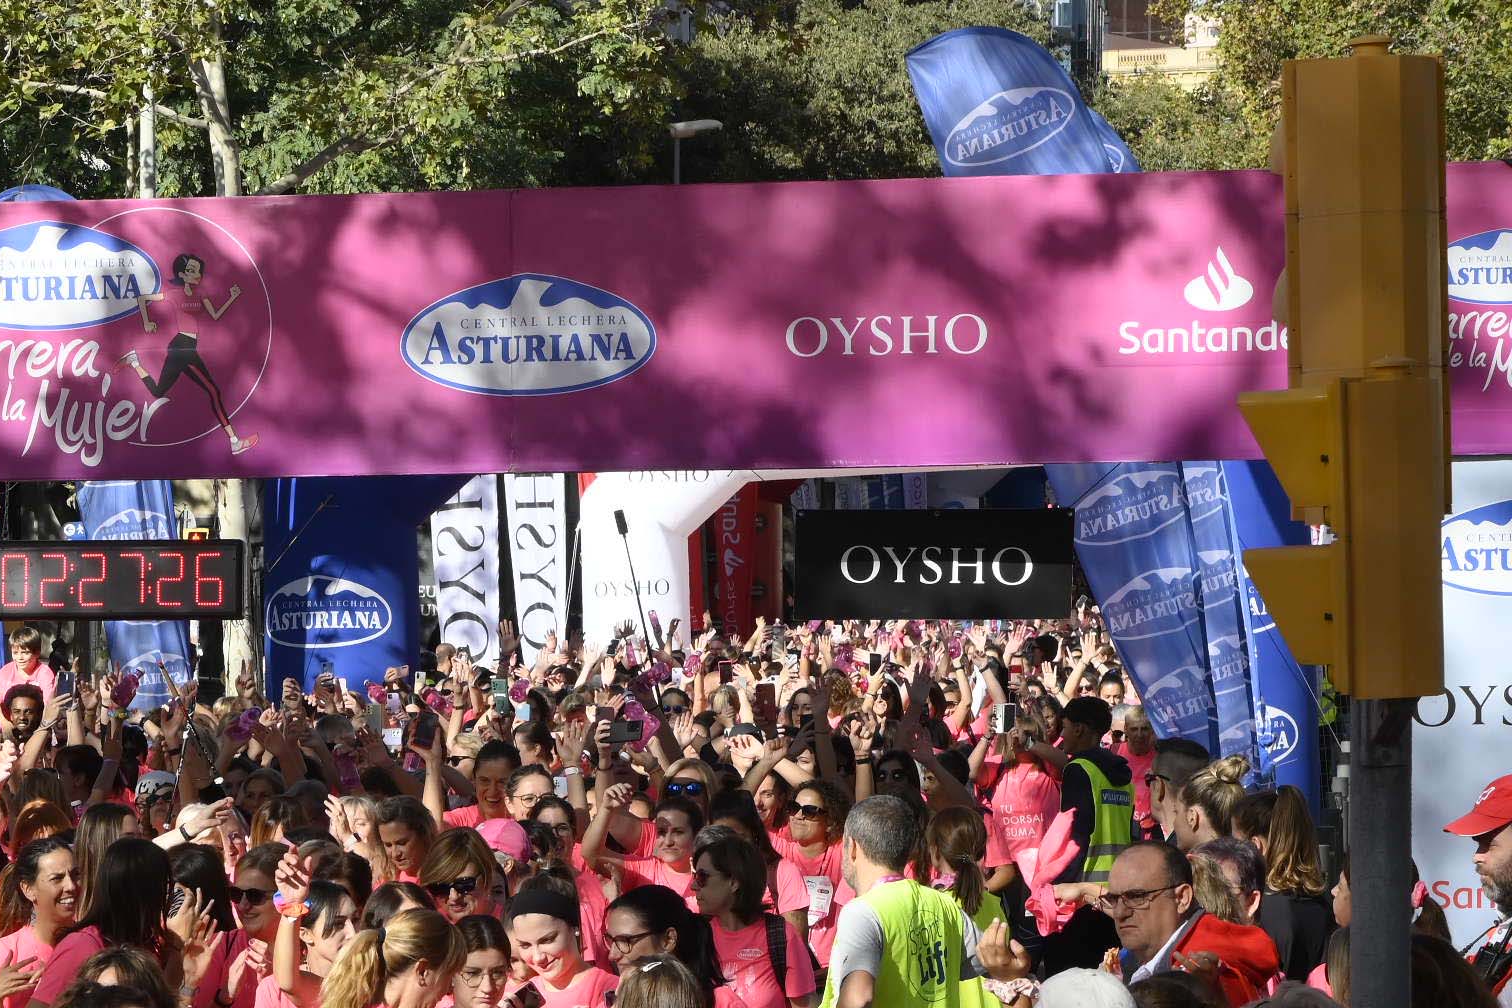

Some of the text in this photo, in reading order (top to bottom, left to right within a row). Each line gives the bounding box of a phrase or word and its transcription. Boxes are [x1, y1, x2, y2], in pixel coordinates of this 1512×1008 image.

[460, 314, 627, 329] CENTRAL LECHERA
[786, 313, 988, 358] OYSHO
[421, 321, 636, 365] ASTURIANA
[1469, 339, 1487, 368] la
[1, 381, 26, 421] la
[22, 371, 171, 466] Mujer
[1466, 533, 1512, 542] CENT
[839, 545, 1034, 585] OYSHO
[1, 553, 223, 608] 02:27:26
[594, 577, 670, 599] OYSHO
[269, 602, 382, 632] ASTURIANA
[282, 599, 378, 609] CENTRAL LECHERA
[1005, 827, 1037, 837] SUMA
